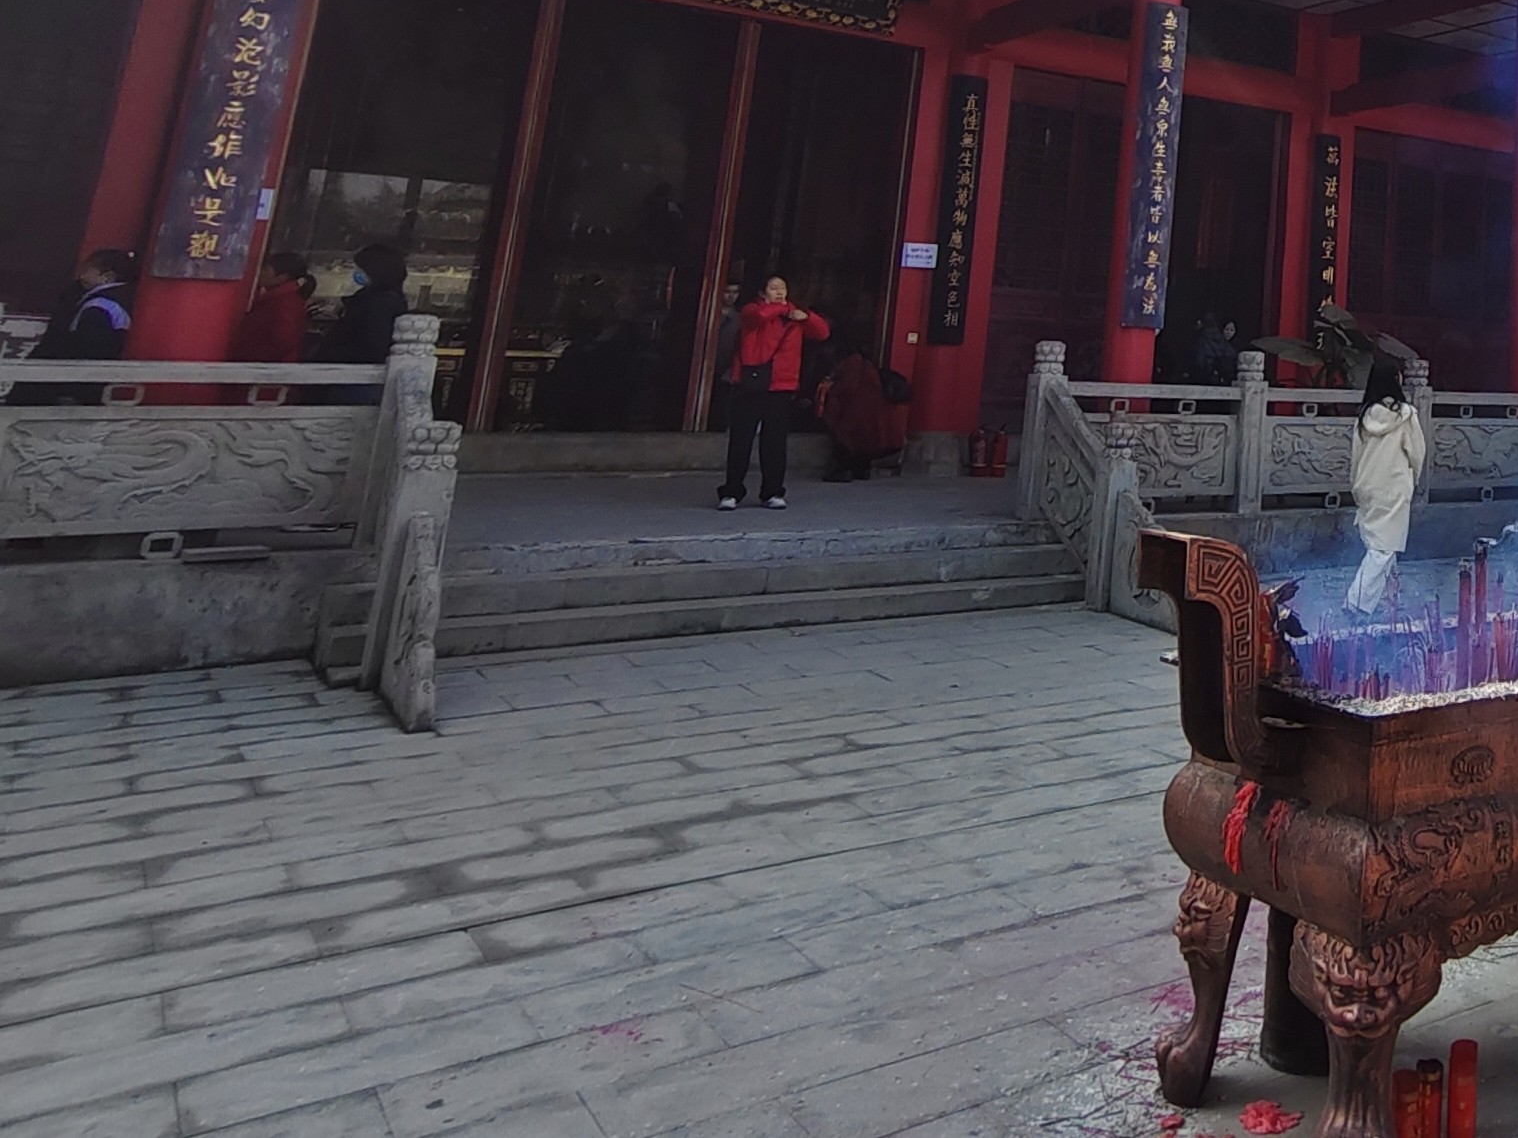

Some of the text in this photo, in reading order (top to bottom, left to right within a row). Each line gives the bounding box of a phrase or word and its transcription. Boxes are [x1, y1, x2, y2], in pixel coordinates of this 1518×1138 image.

[1315, 145, 1340, 350] 萬法皆空明
